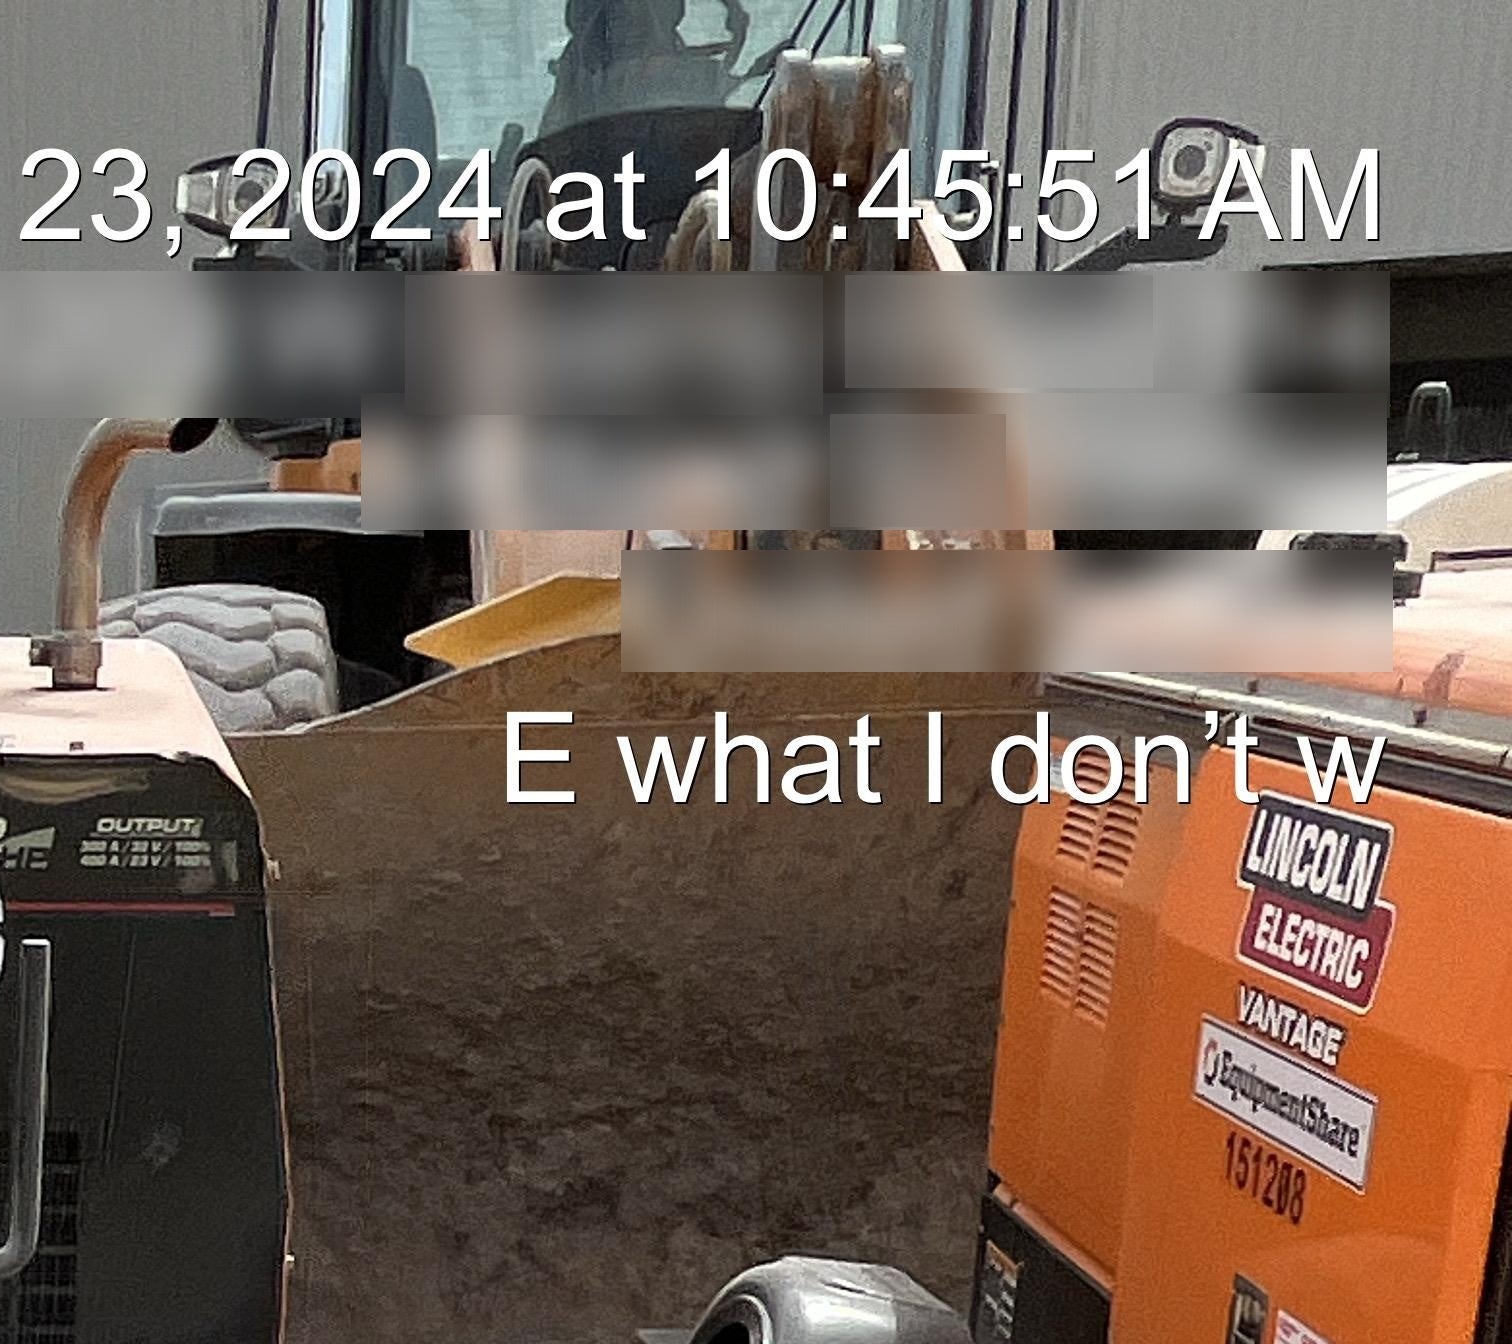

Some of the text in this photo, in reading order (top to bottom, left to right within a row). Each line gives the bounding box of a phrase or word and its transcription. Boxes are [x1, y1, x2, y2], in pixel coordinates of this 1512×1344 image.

[96, 817, 196, 833] OUTPUT
[1246, 808, 1382, 910] LINCOLN
[1253, 902, 1370, 989] ELECTRIC
[1238, 983, 1345, 1067] VANTAGE
[1219, 1049, 1360, 1158] EquipmentShare
[1224, 1130, 1307, 1226] 151208
